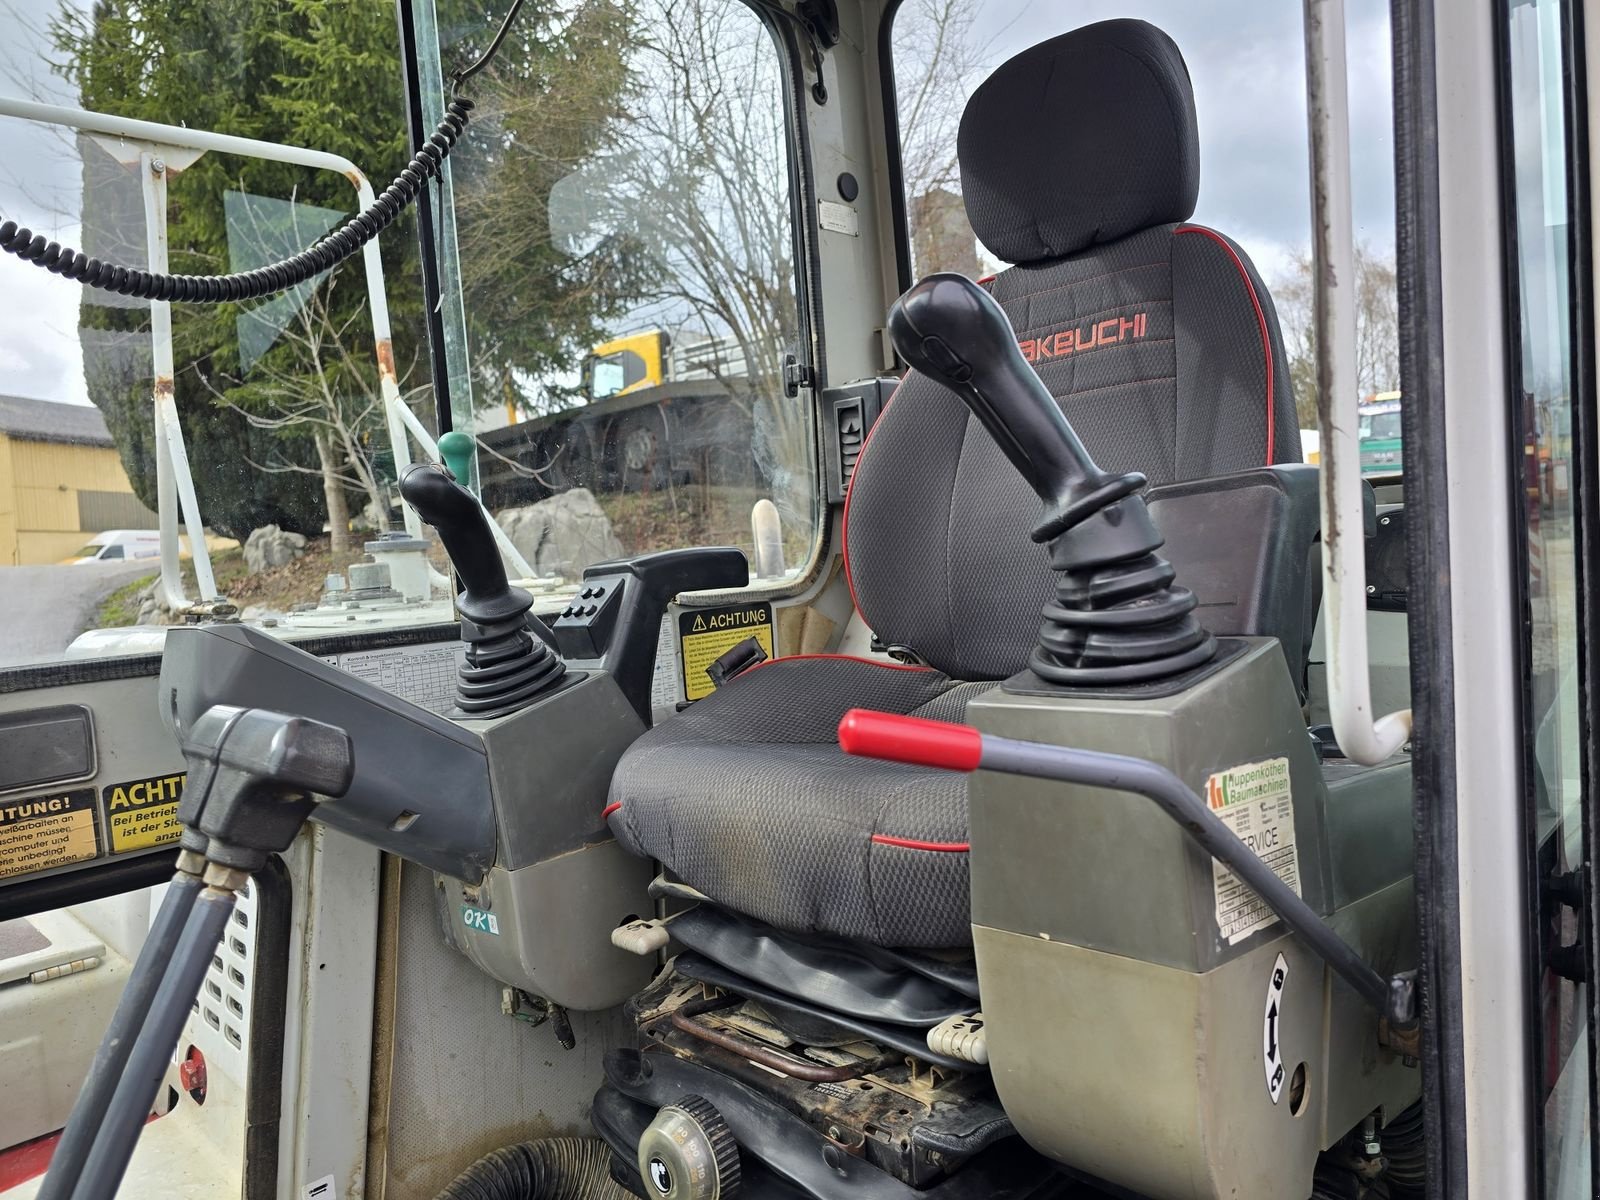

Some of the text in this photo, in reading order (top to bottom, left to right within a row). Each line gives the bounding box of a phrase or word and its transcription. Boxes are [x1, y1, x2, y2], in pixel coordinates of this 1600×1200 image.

[709, 609, 766, 629] ACHTUNG
[1230, 779, 1288, 804] Baumaschinen
[61, 815, 74, 823] an
[113, 806, 178, 826] Bei Betrieb
[36, 826, 72, 838] müssen
[122, 826, 138, 837] ist
[140, 823, 161, 833] der
[52, 835, 70, 845] und
[1241, 827, 1279, 853] RVICE
[17, 845, 67, 863] unbedingt
[43, 853, 78, 867] werden
[464, 909, 487, 930] OK
[687, 1140, 700, 1158] 100
[696, 1163, 706, 1180] 110
